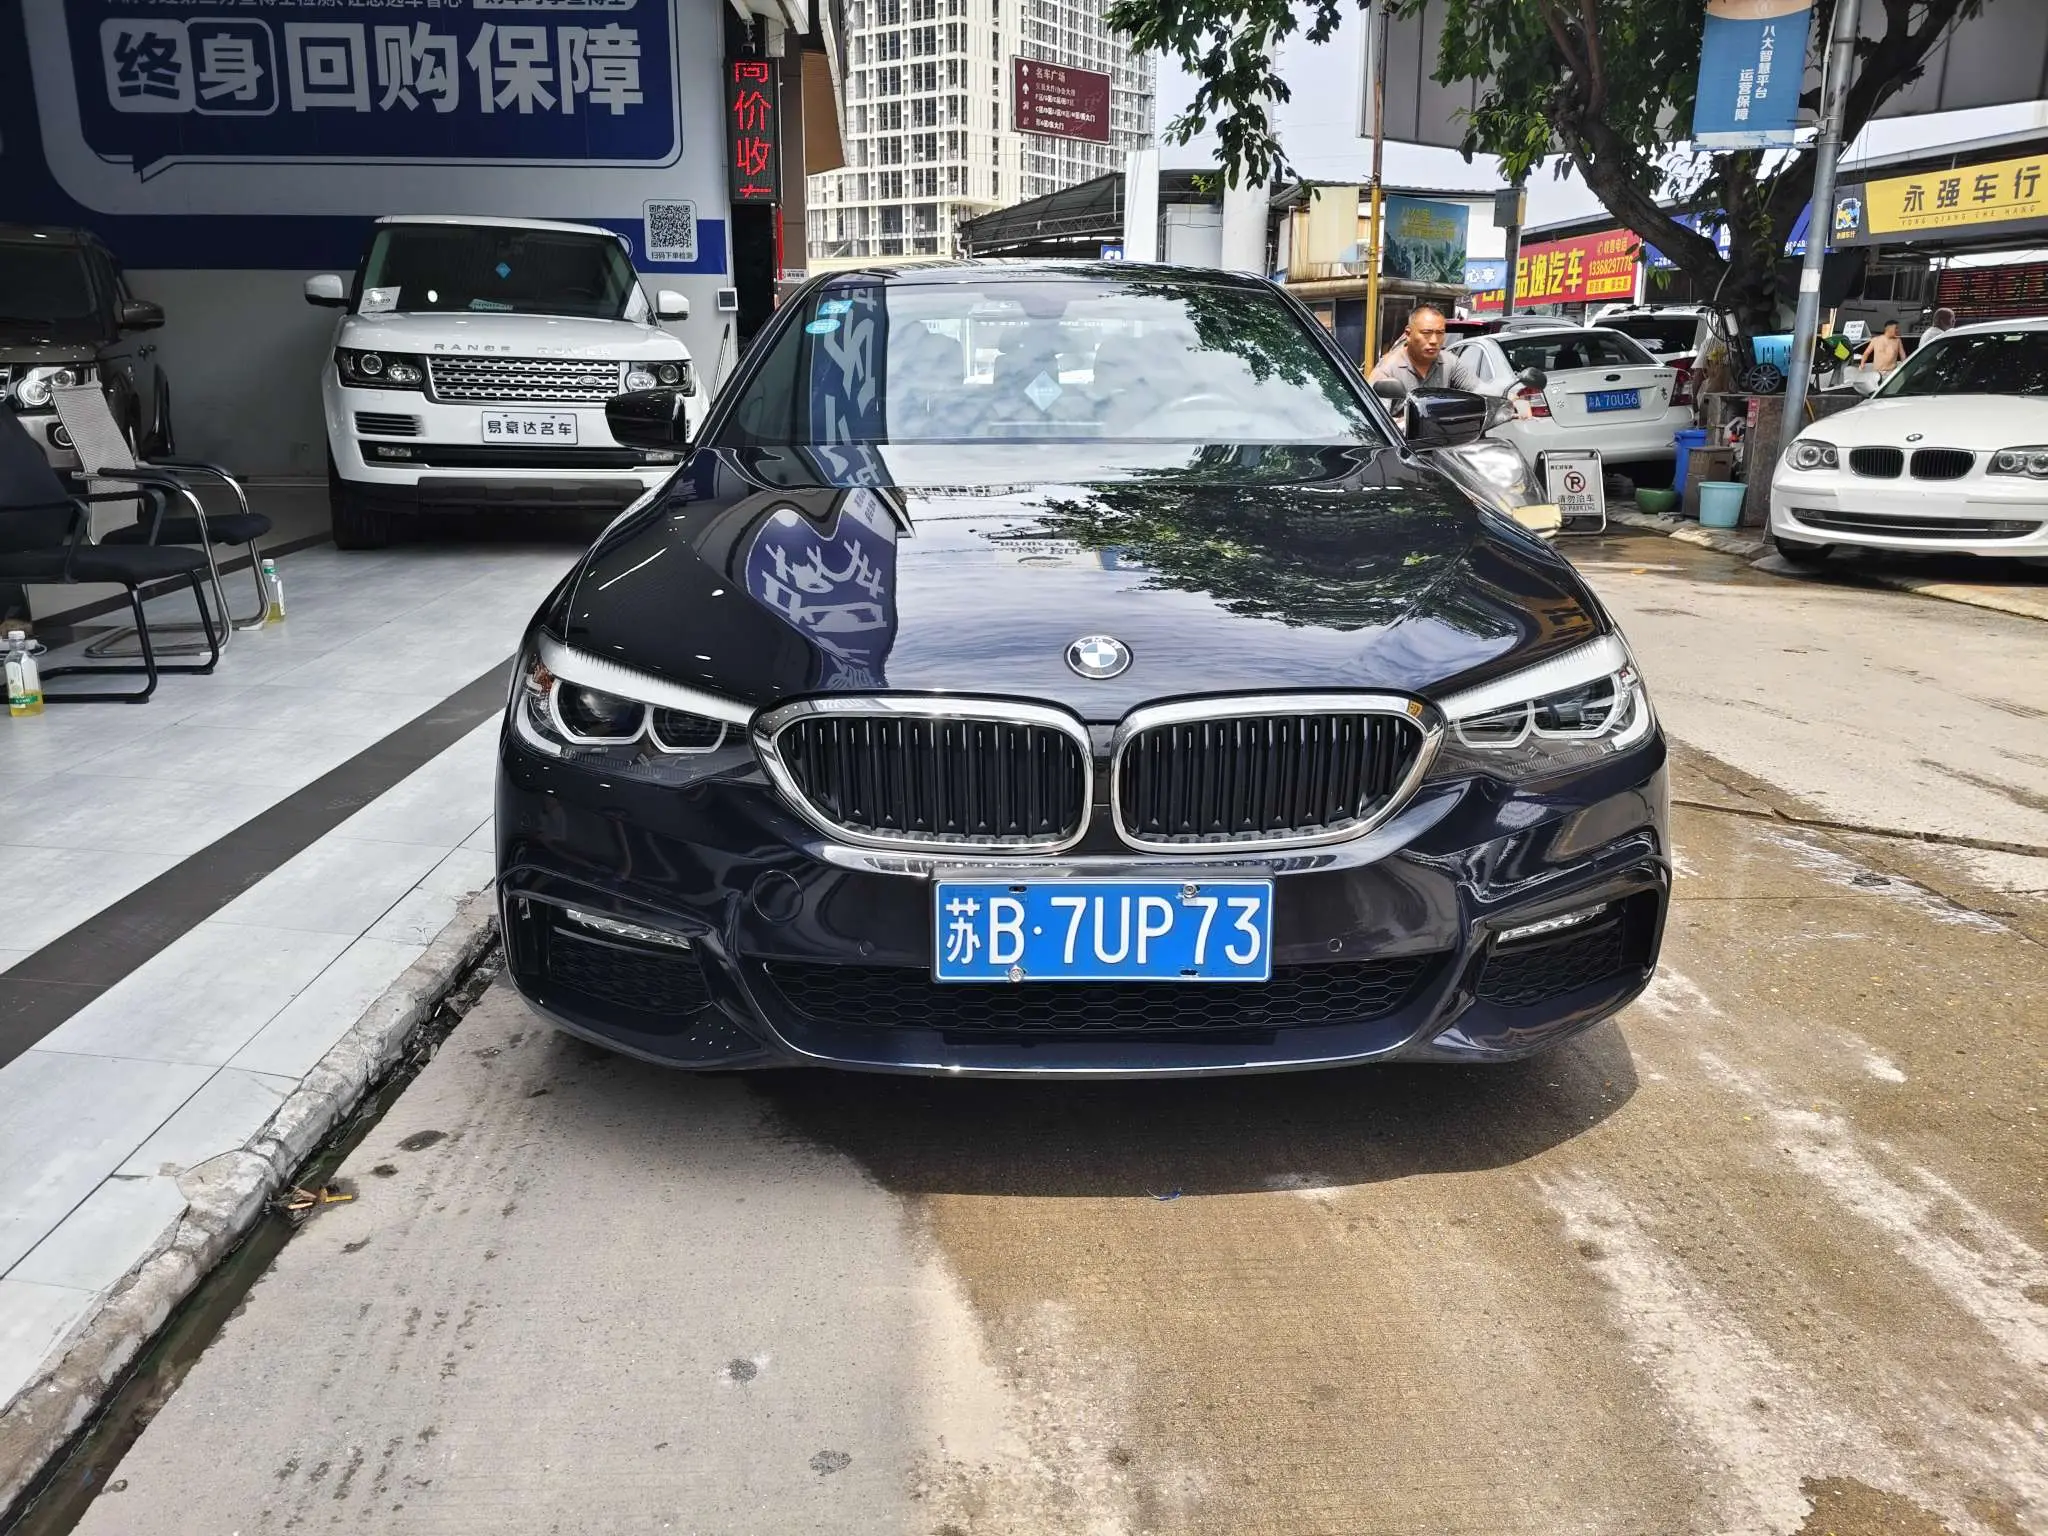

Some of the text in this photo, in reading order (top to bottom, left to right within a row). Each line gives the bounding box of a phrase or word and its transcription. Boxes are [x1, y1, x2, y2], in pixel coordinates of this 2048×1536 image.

[113, 20, 644, 116] 终身回购保障
[1035, 67, 1066, 84] 名车广场
[1755, 25, 1776, 99] 八大智慧平台
[1734, 68, 1755, 121] 运营保障
[1903, 165, 2041, 213] 永强车行
[1902, 204, 2036, 226] YONG QIANG CHE HANG
[434, 343, 511, 352] RANGE
[487, 420, 572, 437] 易豪达名车
